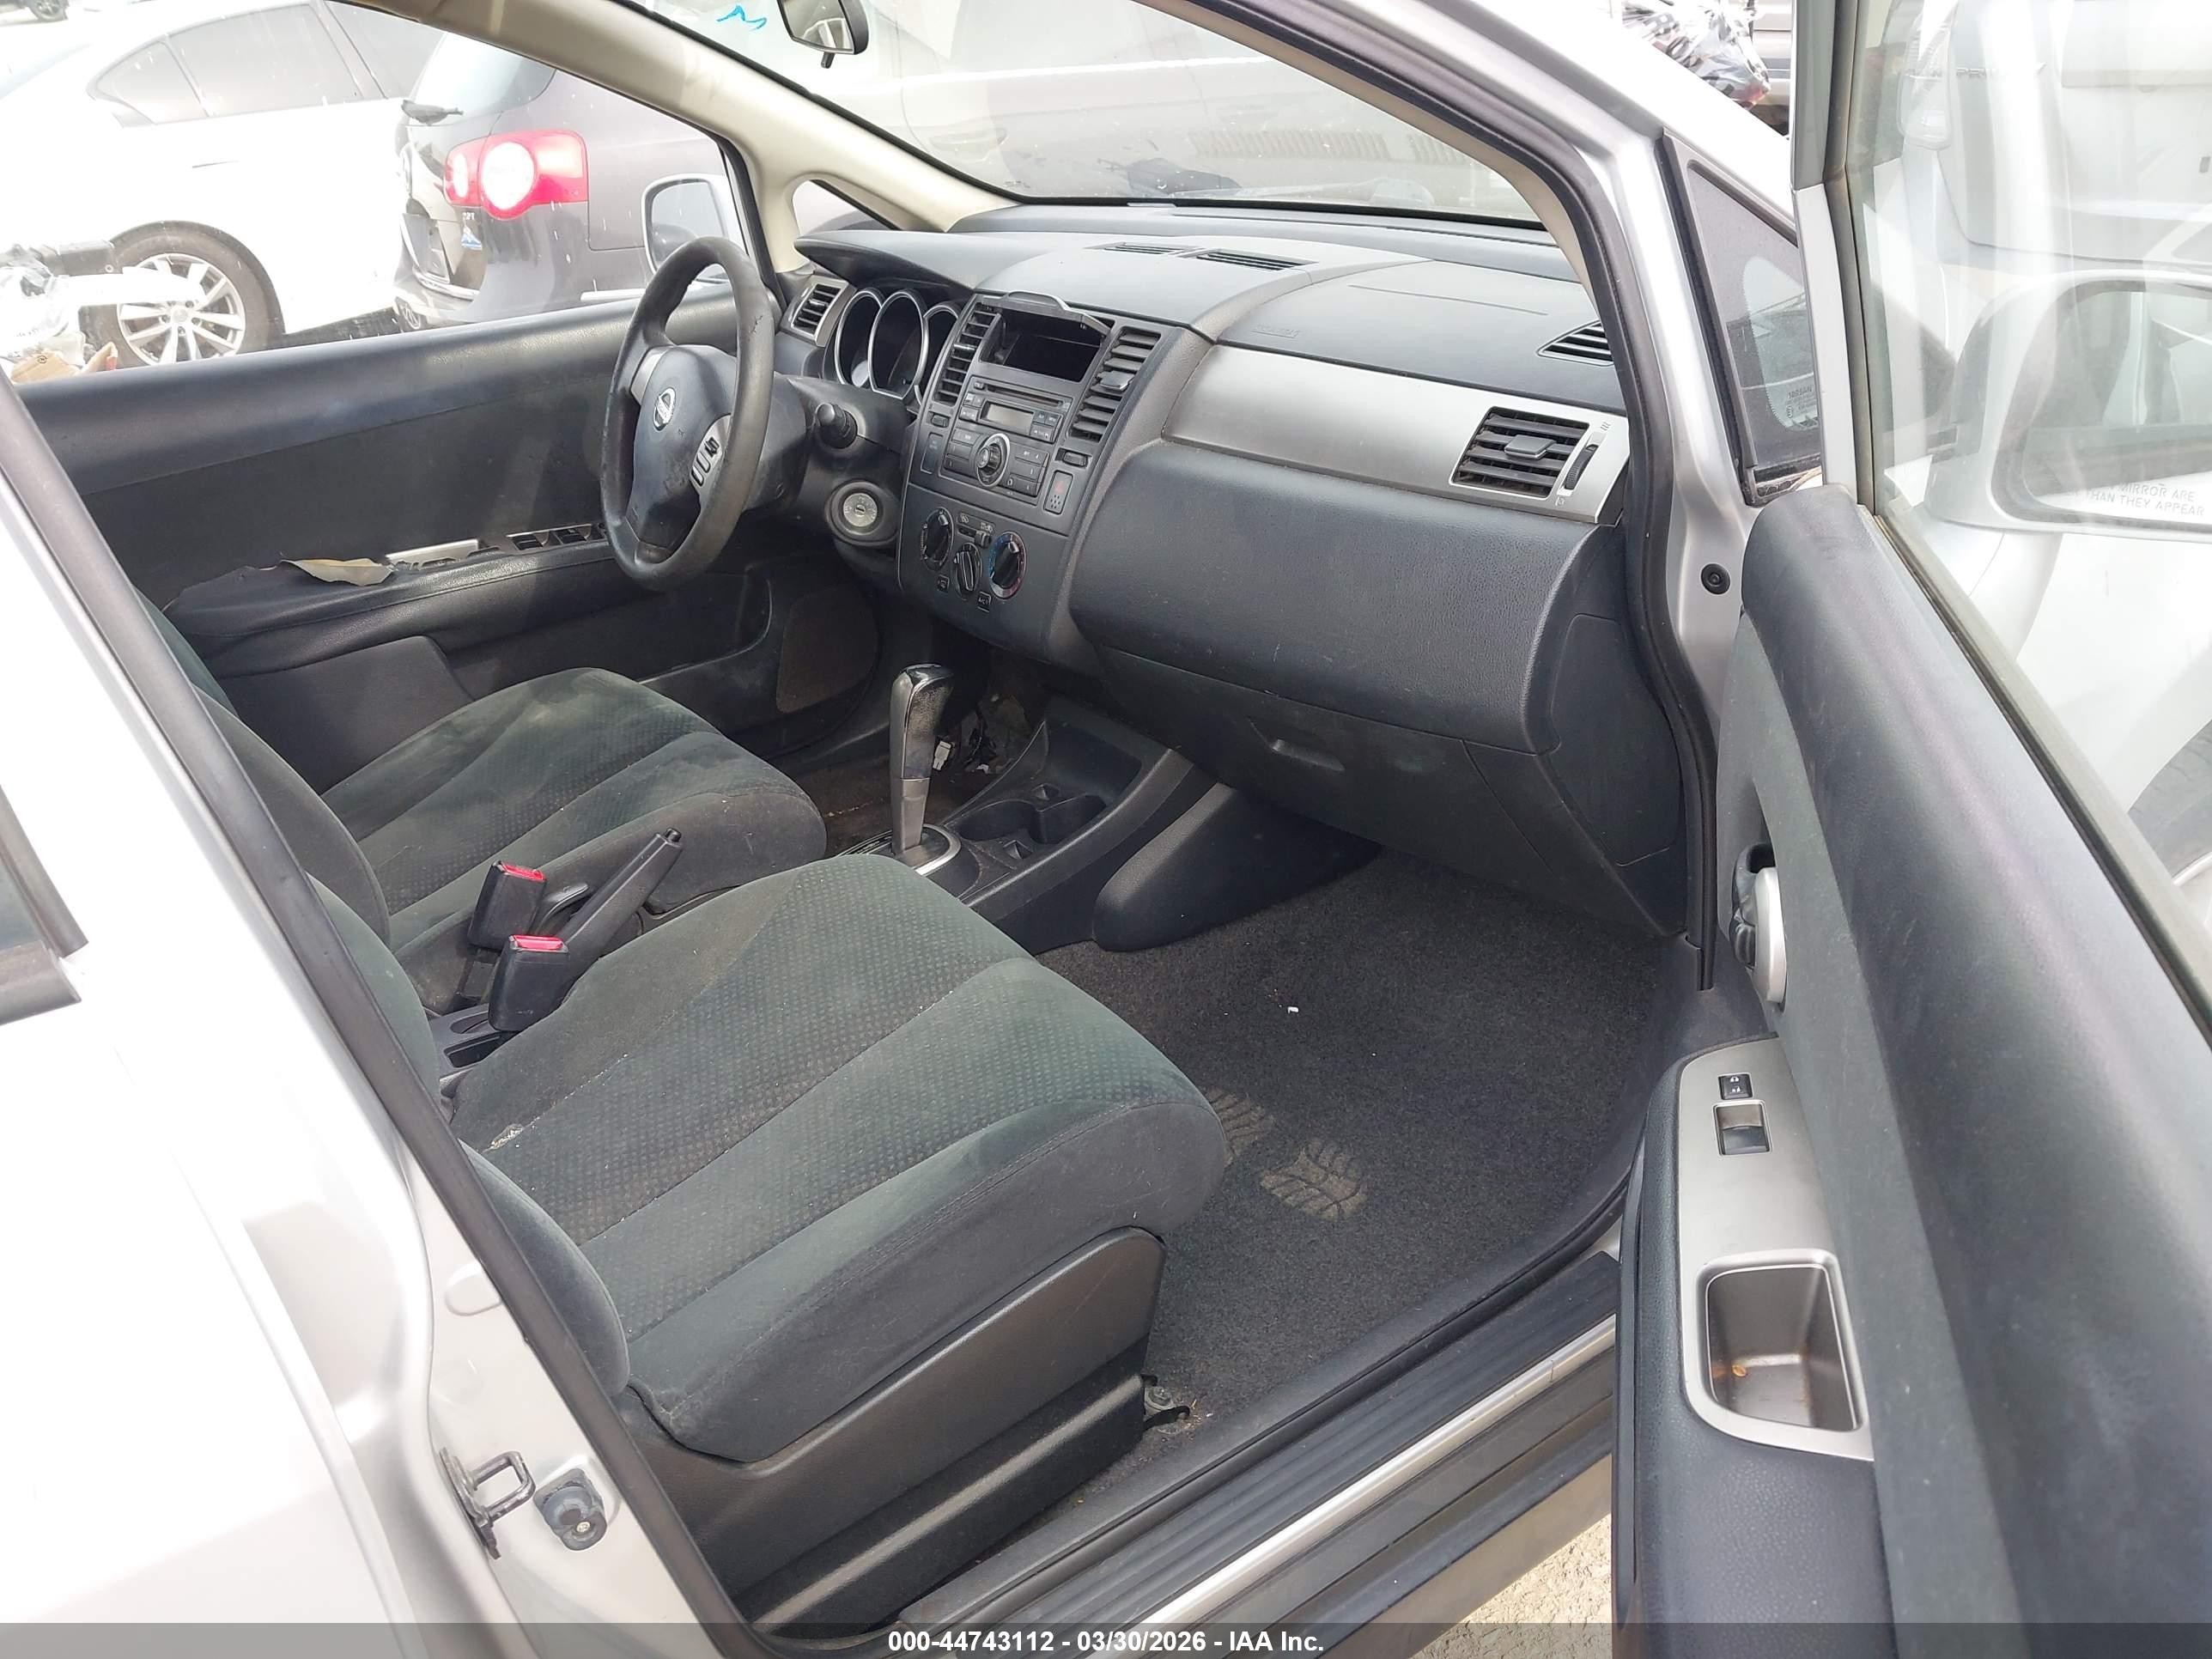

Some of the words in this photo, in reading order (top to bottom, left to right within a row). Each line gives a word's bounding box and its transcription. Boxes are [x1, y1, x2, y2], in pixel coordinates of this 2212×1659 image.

[2118, 481, 2167, 497] MIRROR
[2172, 488, 2196, 502] ARE
[2120, 495, 2151, 508] THEY
[2155, 501, 2205, 517] APPEAR
